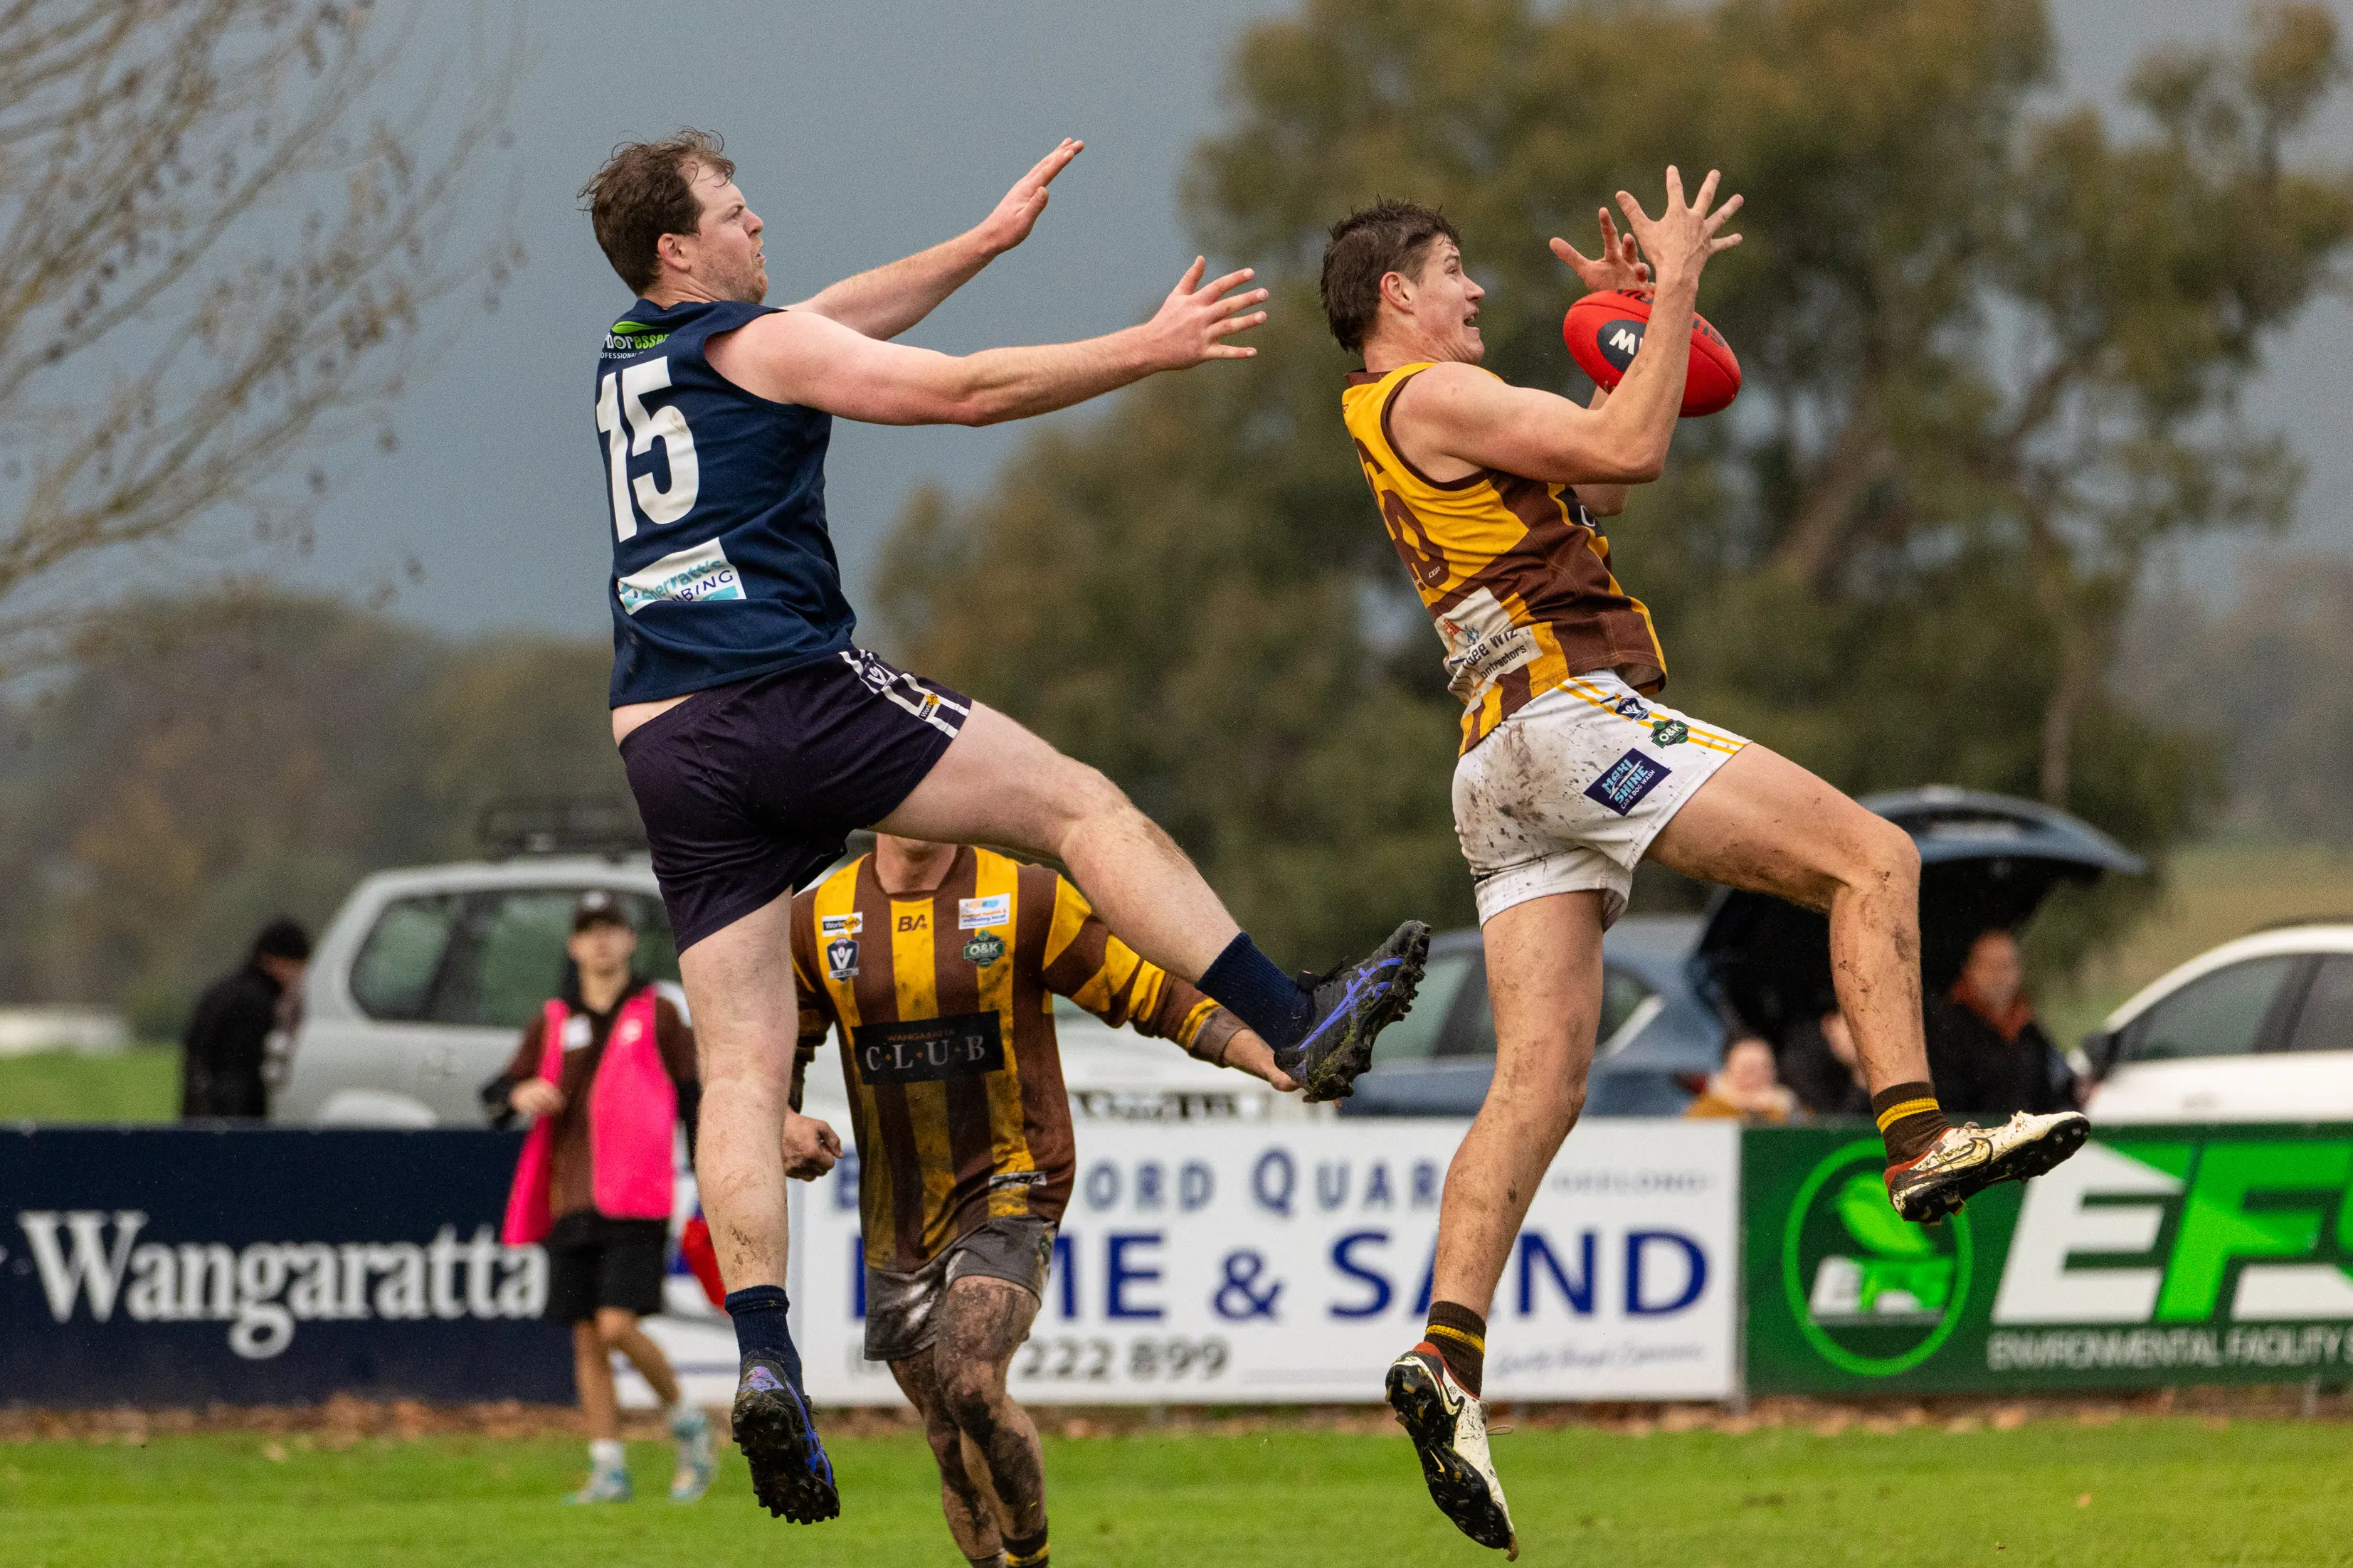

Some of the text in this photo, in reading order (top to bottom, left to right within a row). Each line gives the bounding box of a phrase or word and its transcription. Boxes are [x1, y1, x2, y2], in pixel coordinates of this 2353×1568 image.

[596, 356, 699, 543] 15
[1480, 645, 1527, 679] ontractors
[1659, 724, 1683, 742] O&K
[1614, 765, 1649, 804] SHINE
[1620, 798, 1631, 810] CAR
[1632, 784, 1643, 796] DOG
[1640, 769, 1656, 785] WASH
[969, 943, 999, 955] O&K
[17, 1209, 552, 1360] Wangaratta
[1214, 1249, 1285, 1320] &
[1328, 1228, 1710, 1319] SND
